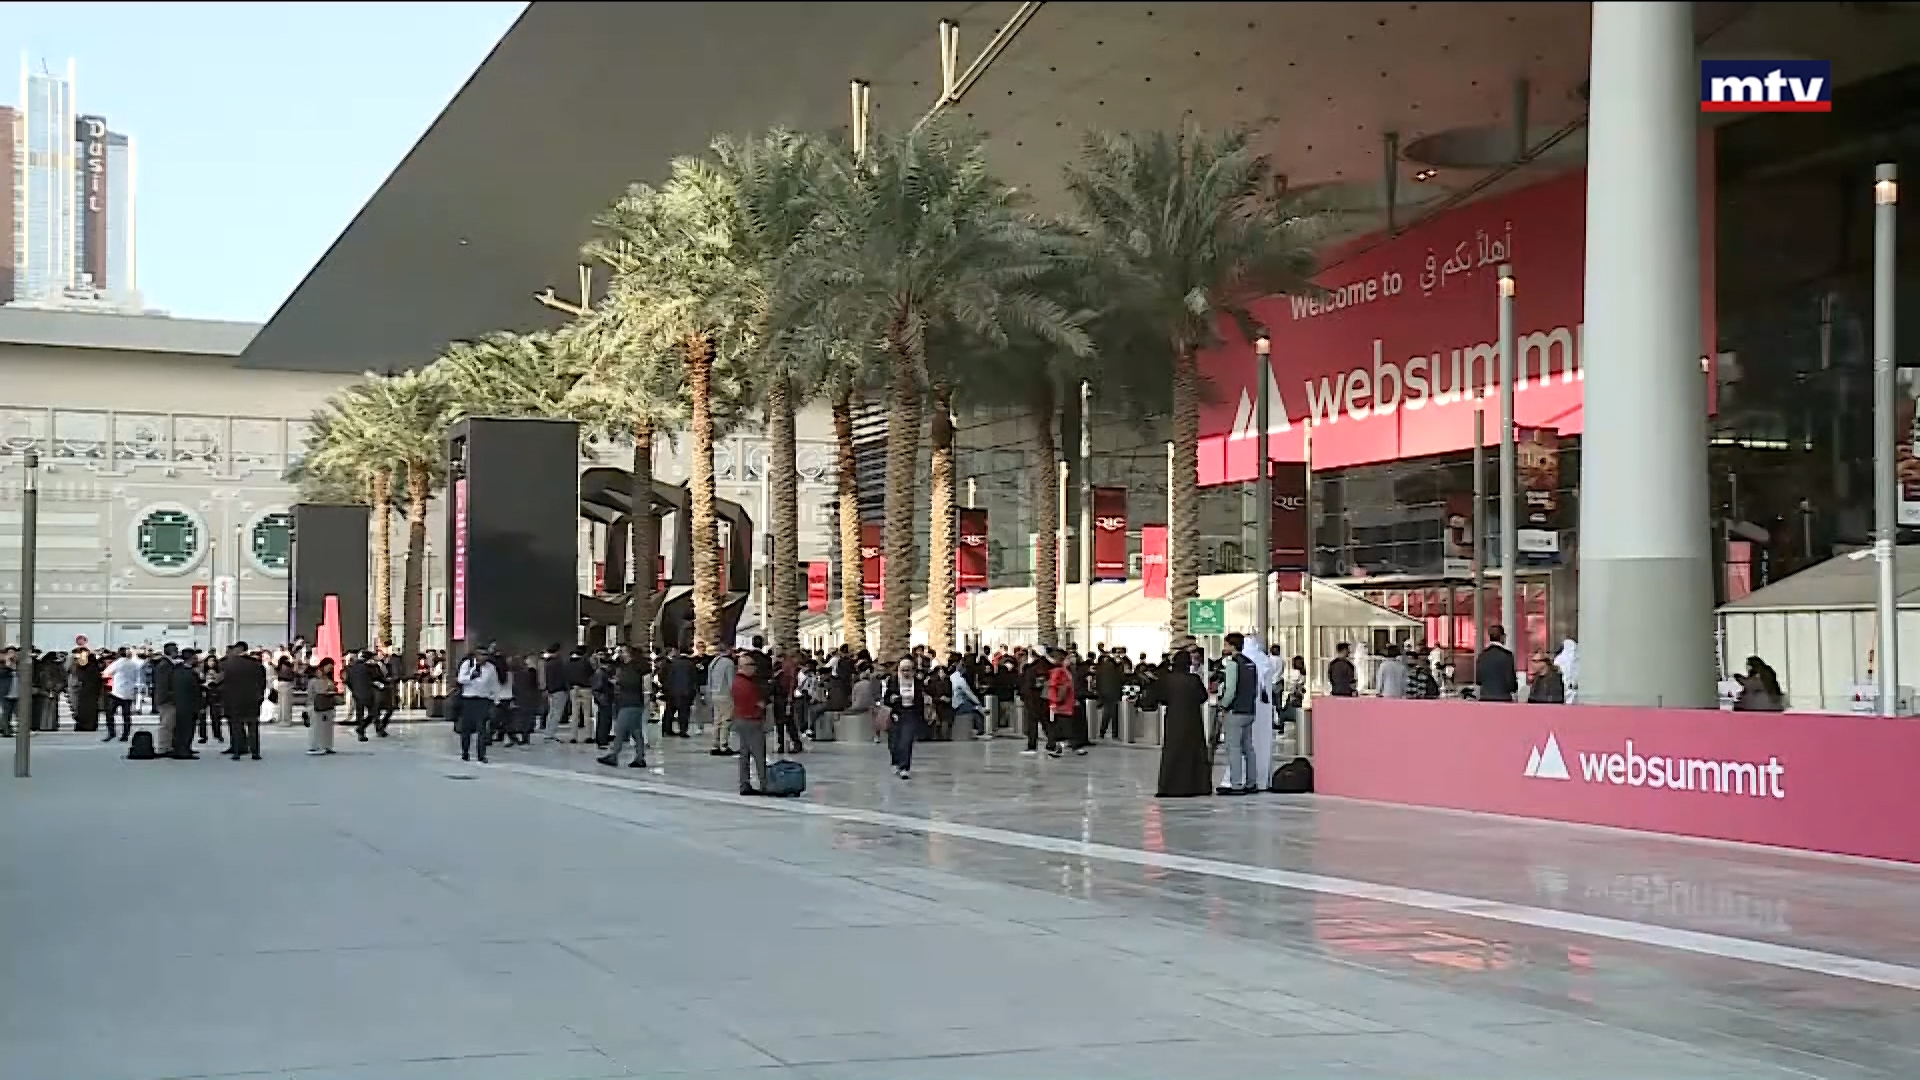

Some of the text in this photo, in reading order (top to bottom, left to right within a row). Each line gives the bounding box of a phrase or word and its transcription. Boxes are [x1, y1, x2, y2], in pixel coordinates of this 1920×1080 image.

[1419, 247, 1437, 297] في
[1441, 241, 1472, 288] بكم
[1291, 271, 1402, 320] Welcome to
[1579, 739, 1785, 799] websummit
